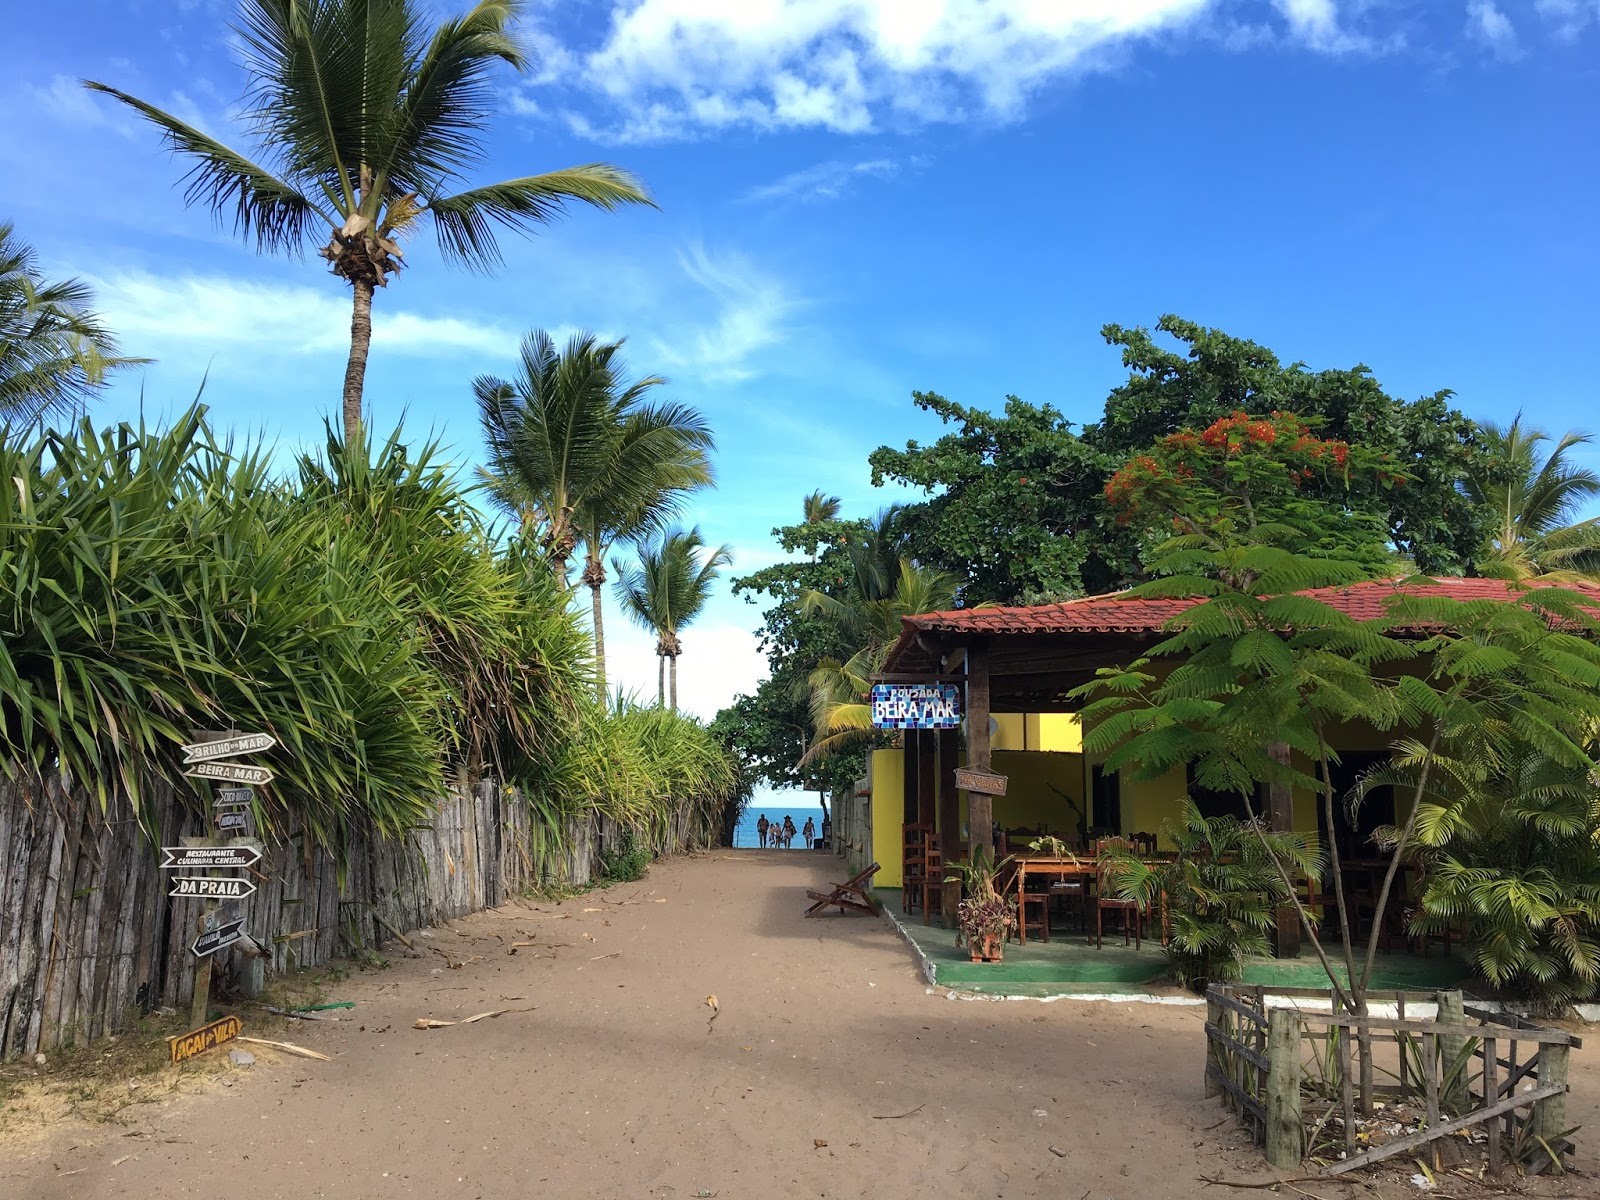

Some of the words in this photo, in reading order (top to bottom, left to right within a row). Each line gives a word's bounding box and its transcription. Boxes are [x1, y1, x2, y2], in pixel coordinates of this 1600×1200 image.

[891, 688, 941, 698] POUSADA
[924, 701, 955, 719] MAR
[195, 743, 231, 758] BRILHO
[239, 737, 264, 751] MAR
[197, 764, 230, 777] BEIRA
[234, 768, 262, 781] MAR
[179, 880, 197, 893] DA
[199, 881, 240, 895] PRAIA
[213, 1020, 237, 1044] VILA
